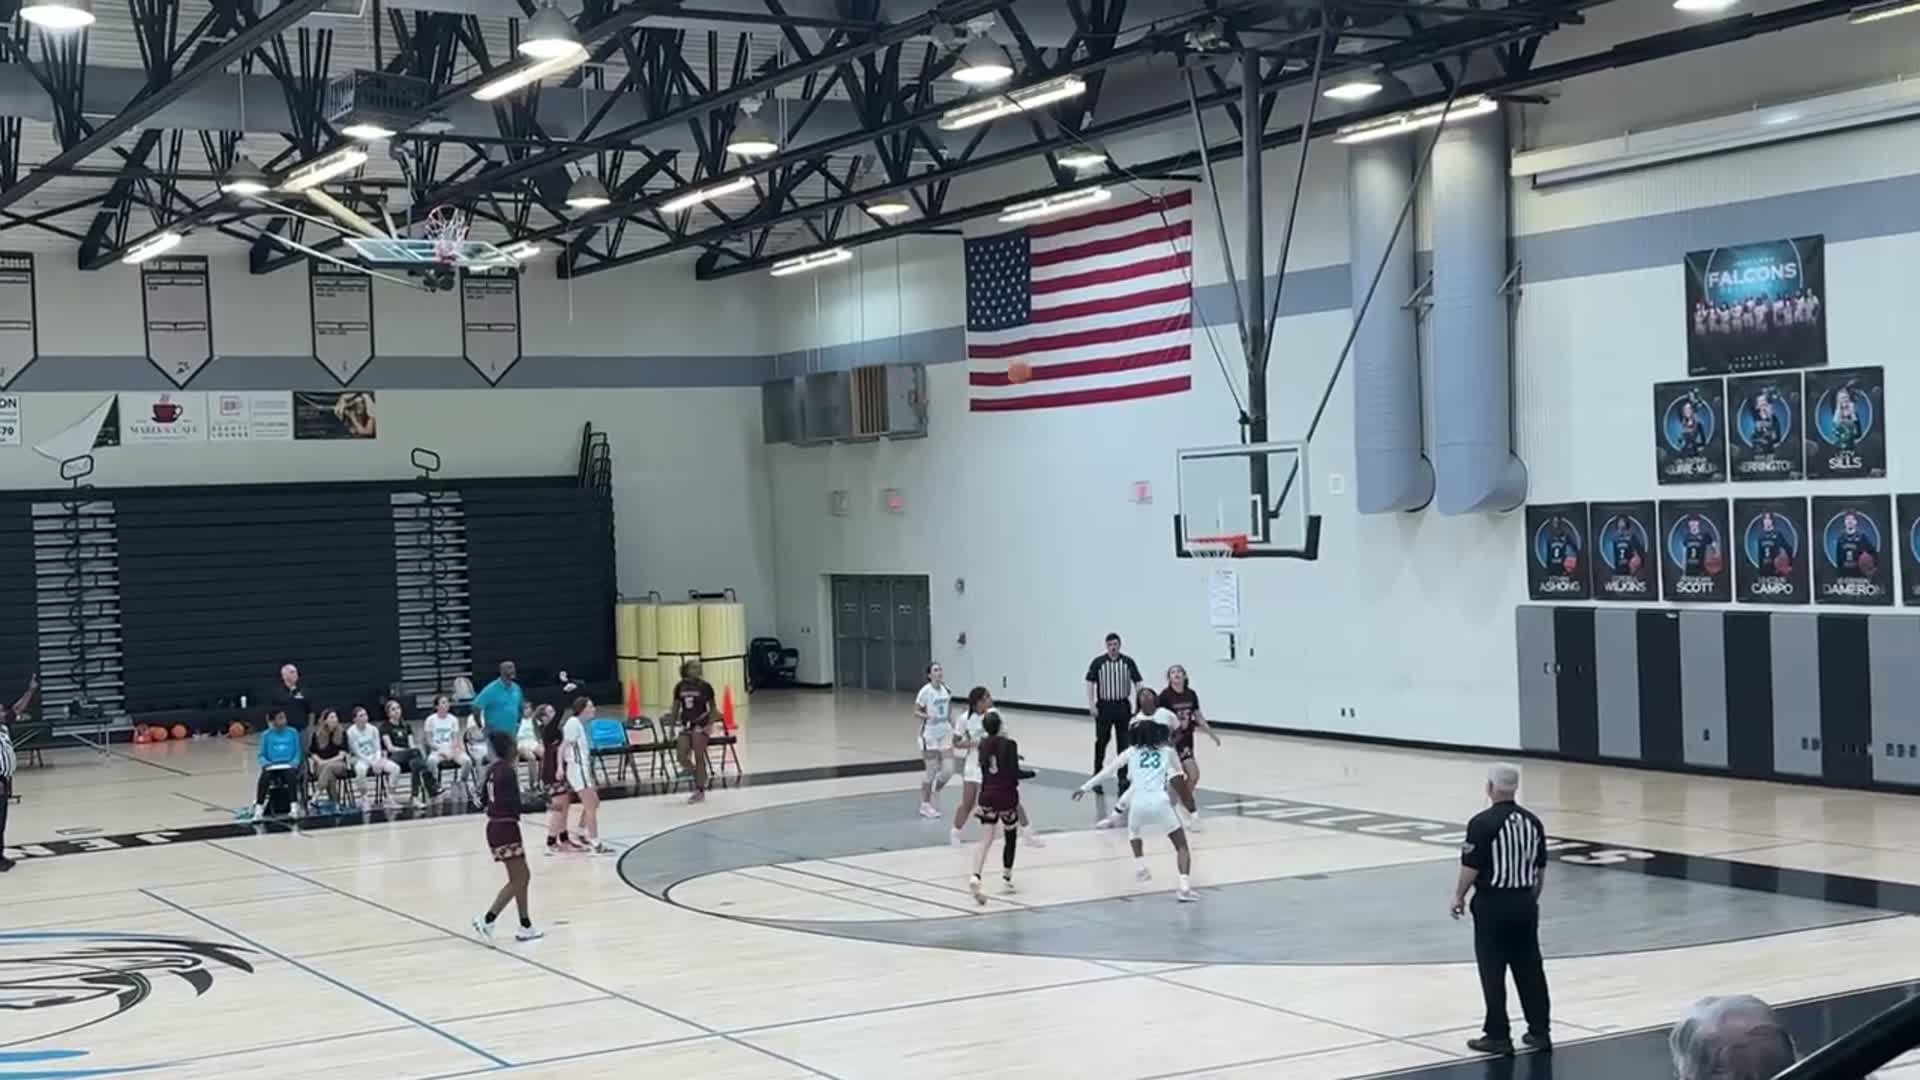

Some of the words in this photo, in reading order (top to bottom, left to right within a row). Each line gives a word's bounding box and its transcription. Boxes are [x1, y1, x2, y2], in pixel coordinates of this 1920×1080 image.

[1708, 262, 1798, 288] FALCONS
[1829, 456, 1864, 470] SILLS
[1604, 581, 1647, 593] WILKINS
[1676, 582, 1715, 594] SCOTT
[1751, 582, 1794, 594] CAMPO
[1140, 752, 1162, 769] 23
[1207, 797, 1656, 866] FALCS
